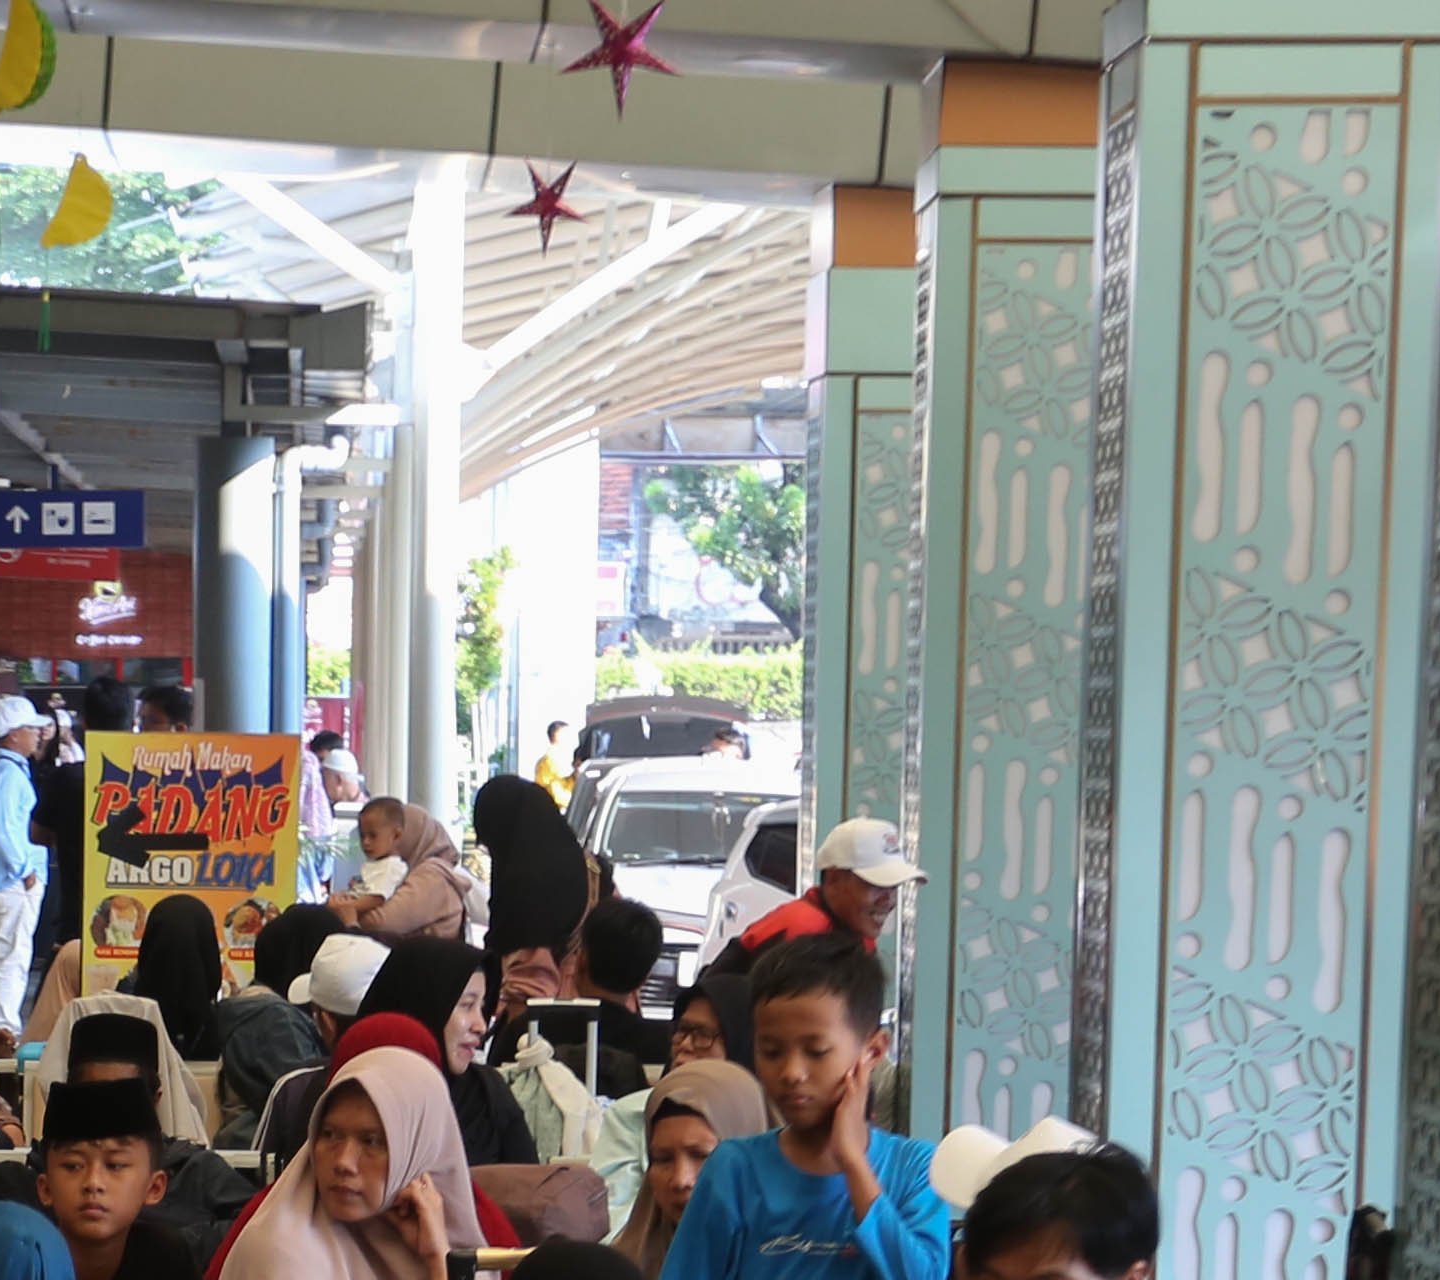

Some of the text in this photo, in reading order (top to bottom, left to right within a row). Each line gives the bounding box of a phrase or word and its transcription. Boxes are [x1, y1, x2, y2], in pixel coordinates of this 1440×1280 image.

[132, 741, 253, 777] Rumah Makan
[92, 780, 291, 845] PADANG
[106, 855, 193, 885] ARGO
